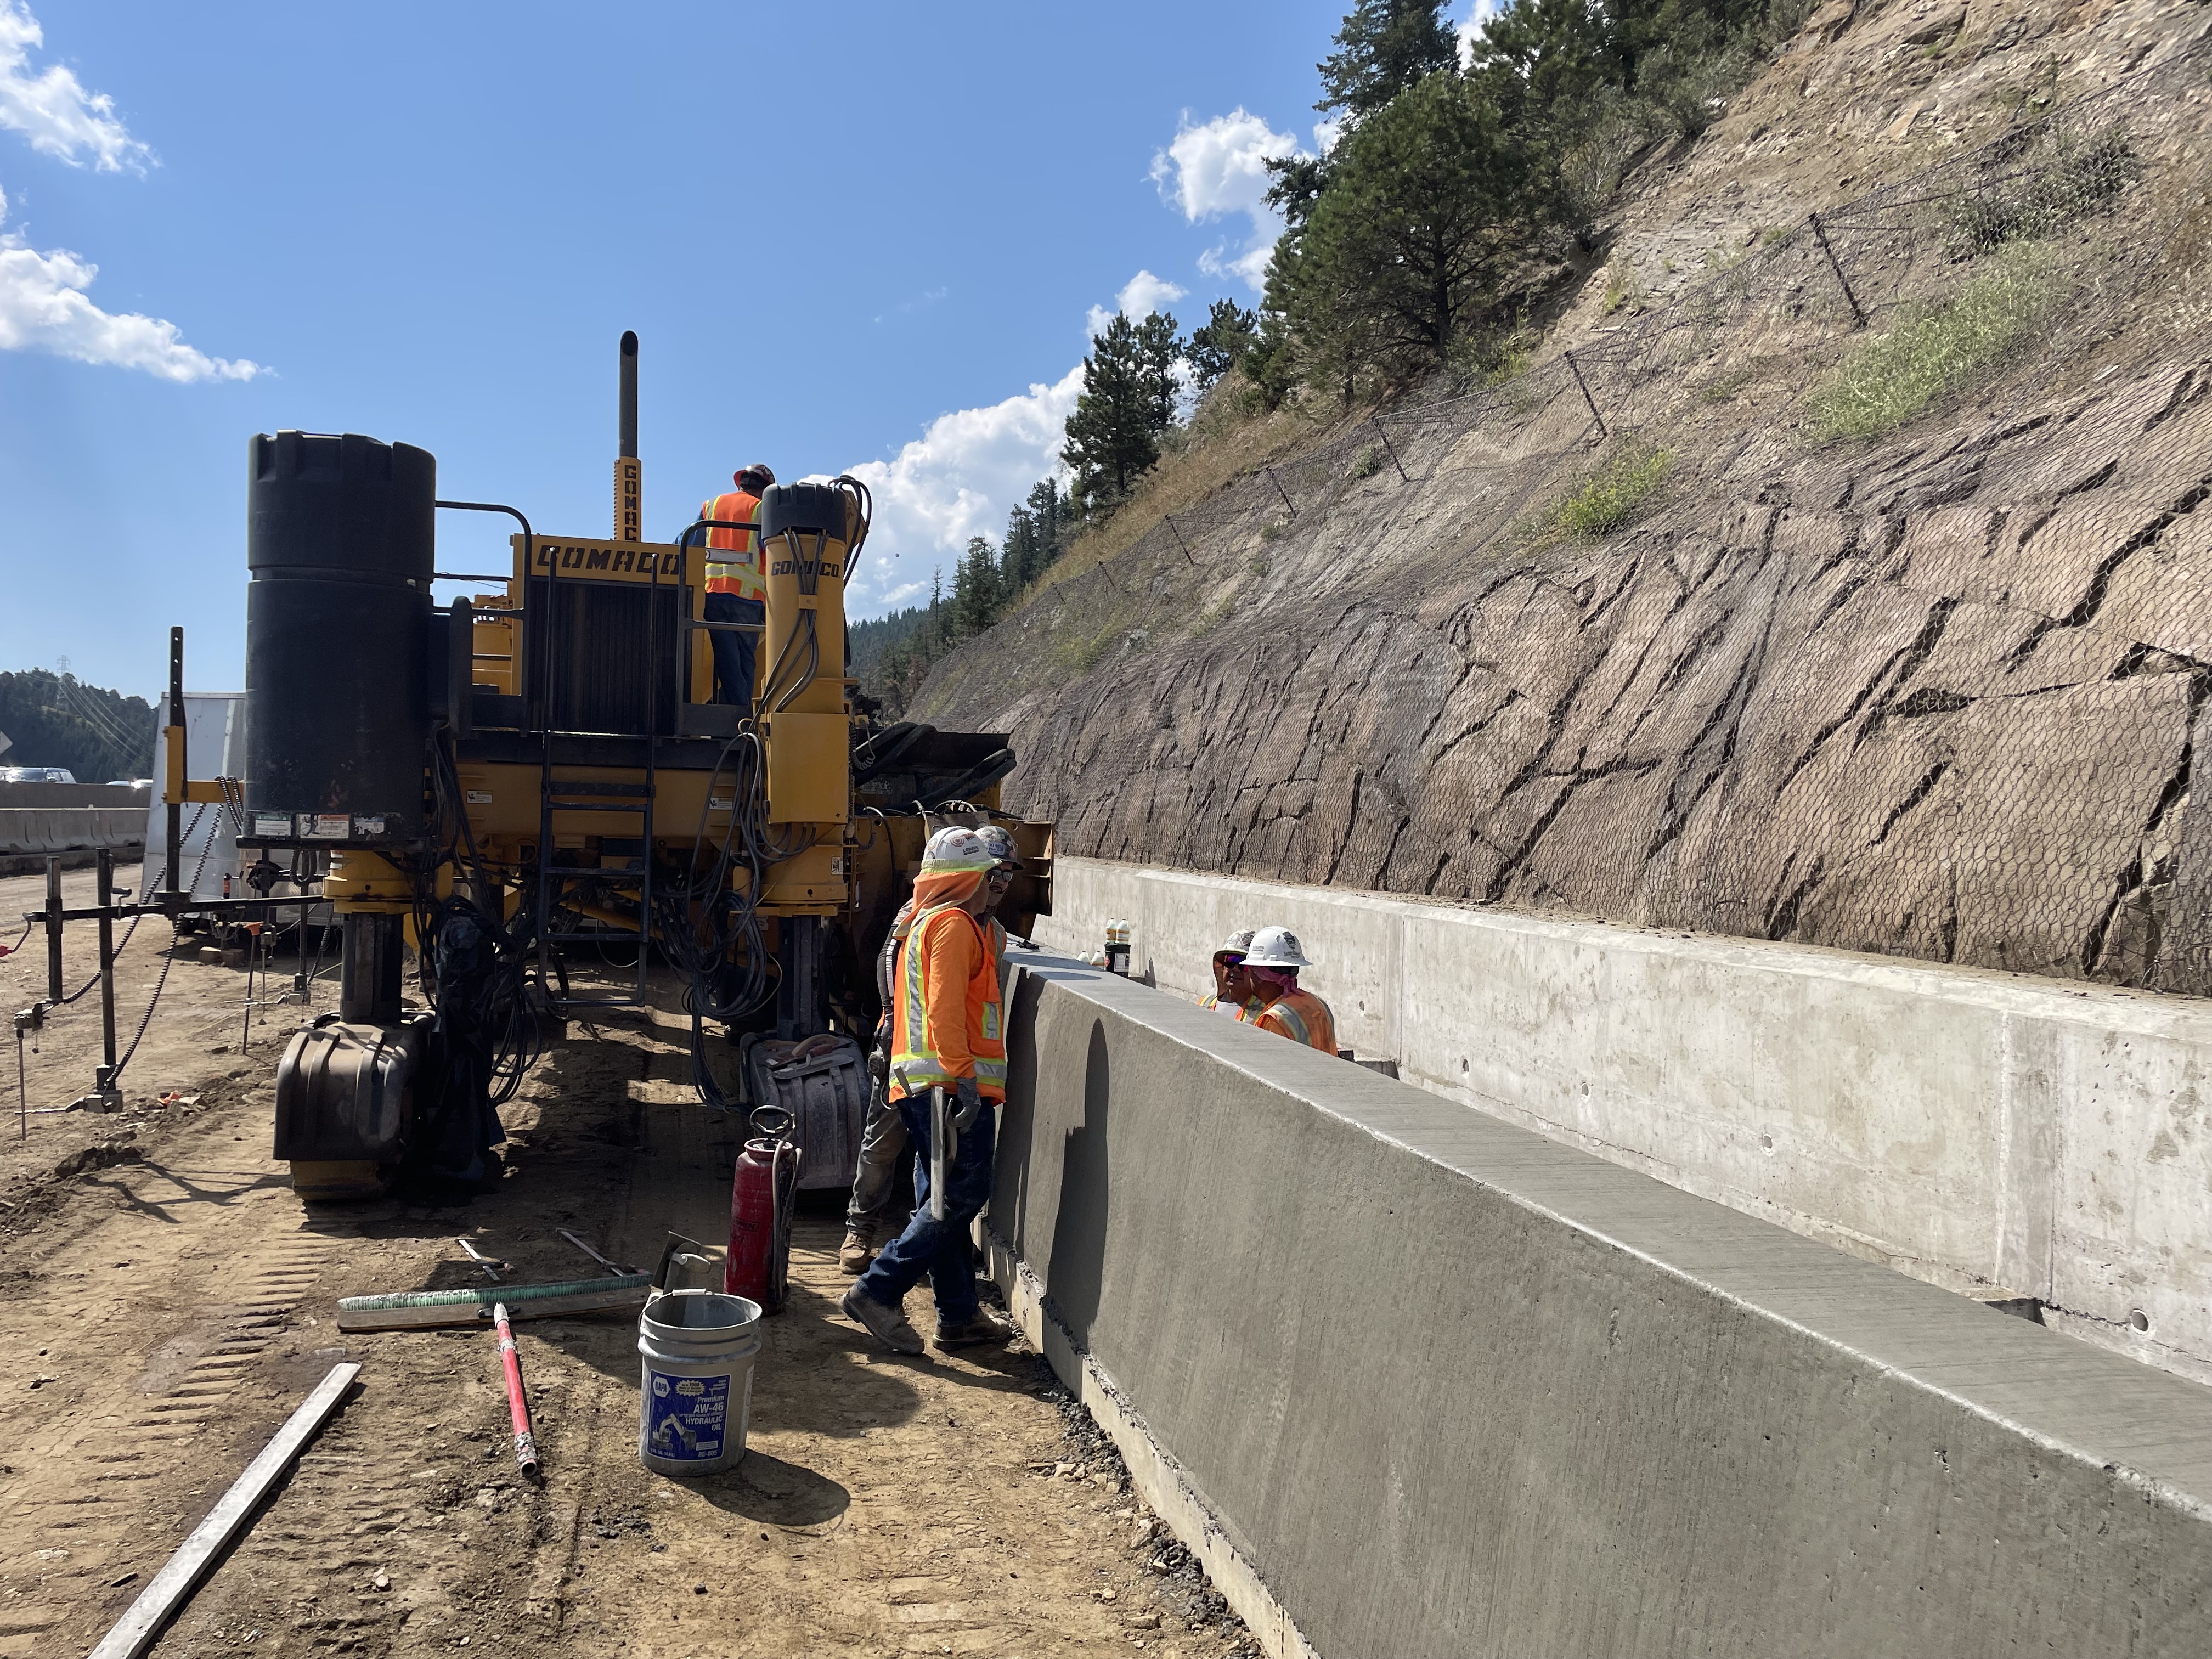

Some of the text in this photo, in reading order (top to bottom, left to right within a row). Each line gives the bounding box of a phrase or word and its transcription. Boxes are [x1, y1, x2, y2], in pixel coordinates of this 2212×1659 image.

[537, 545, 681, 575] GOMACO
[655, 1380, 667, 1393] NAPA
[693, 1402, 724, 1414] AW-46
[686, 1415, 723, 1425] HYDRAULIC
